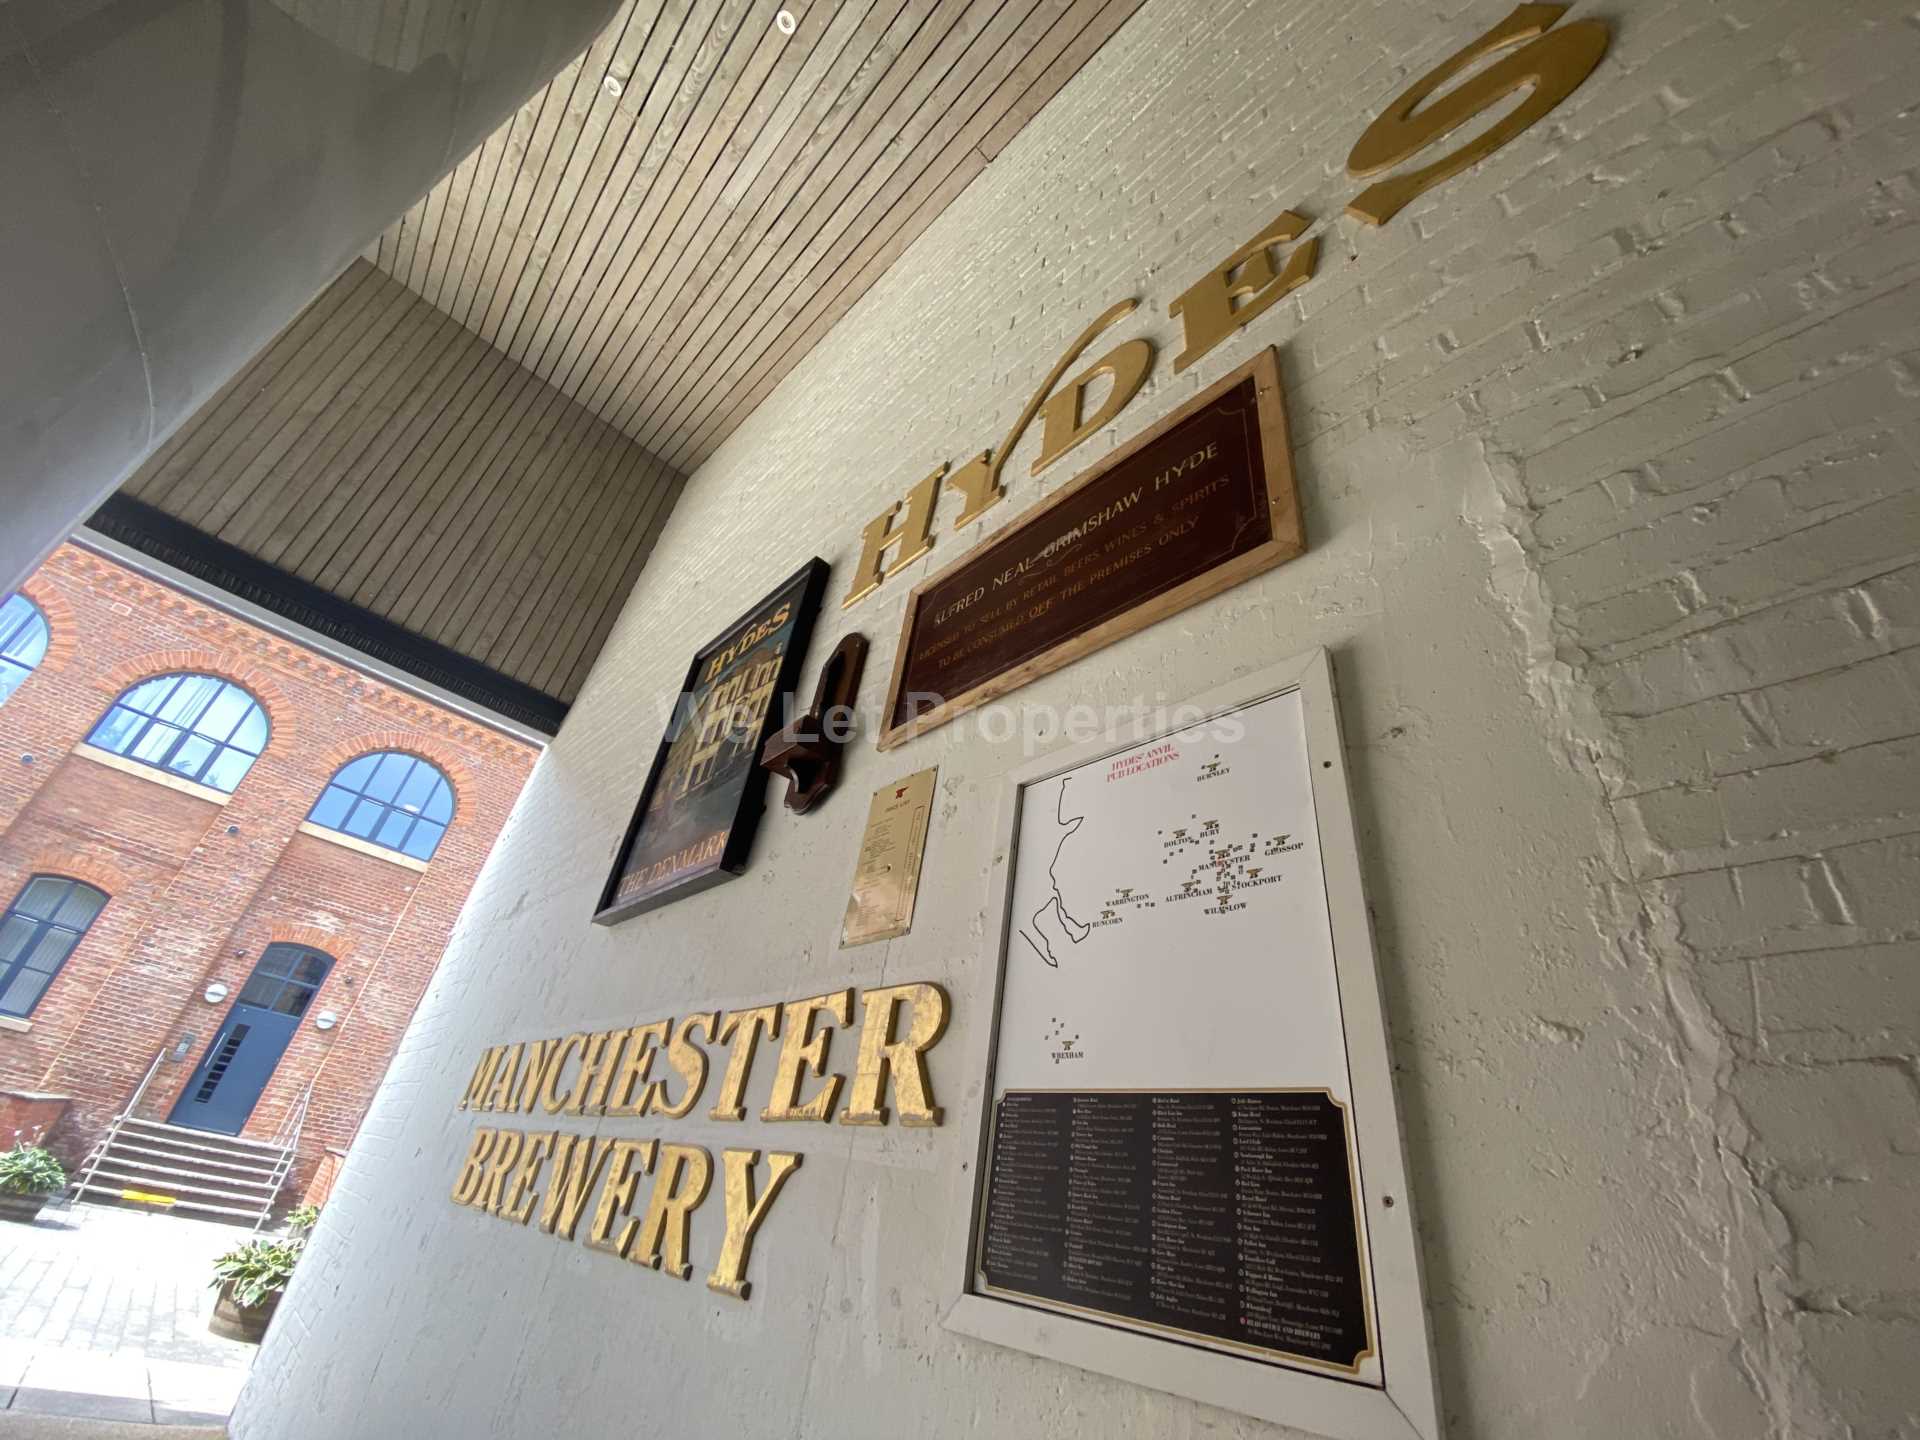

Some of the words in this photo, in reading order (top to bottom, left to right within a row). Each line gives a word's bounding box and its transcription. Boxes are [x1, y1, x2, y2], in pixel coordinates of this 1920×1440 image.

[842, 3, 1611, 608] HYDES
[1104, 521, 1147, 553] WINES
[1153, 512, 1165, 525] &
[1171, 473, 1230, 513] SPIRITS
[935, 587, 985, 625] ALFRED
[992, 558, 1034, 590] NEAL
[1042, 486, 1143, 558] GRIMSHAW
[1154, 442, 1218, 491] HYDE
[1029, 597, 1056, 618] OFF
[1060, 581, 1083, 602] THE
[1089, 546, 1153, 585] PREMISES
[1158, 514, 1200, 546] ONLY
[1196, 767, 1231, 783] BURNLEY
[1163, 836, 1193, 849] BOLTON
[1200, 828, 1220, 839] BURY
[1264, 842, 1304, 857] GLOSSOP
[1198, 854, 1251, 872] MANSTER
[1231, 874, 1284, 892] STOCKPORT
[1165, 887, 1213, 903] ALTRINCHAM
[457, 980, 952, 1128] MANCHESTER
[450, 1126, 804, 1300] BREWERY
